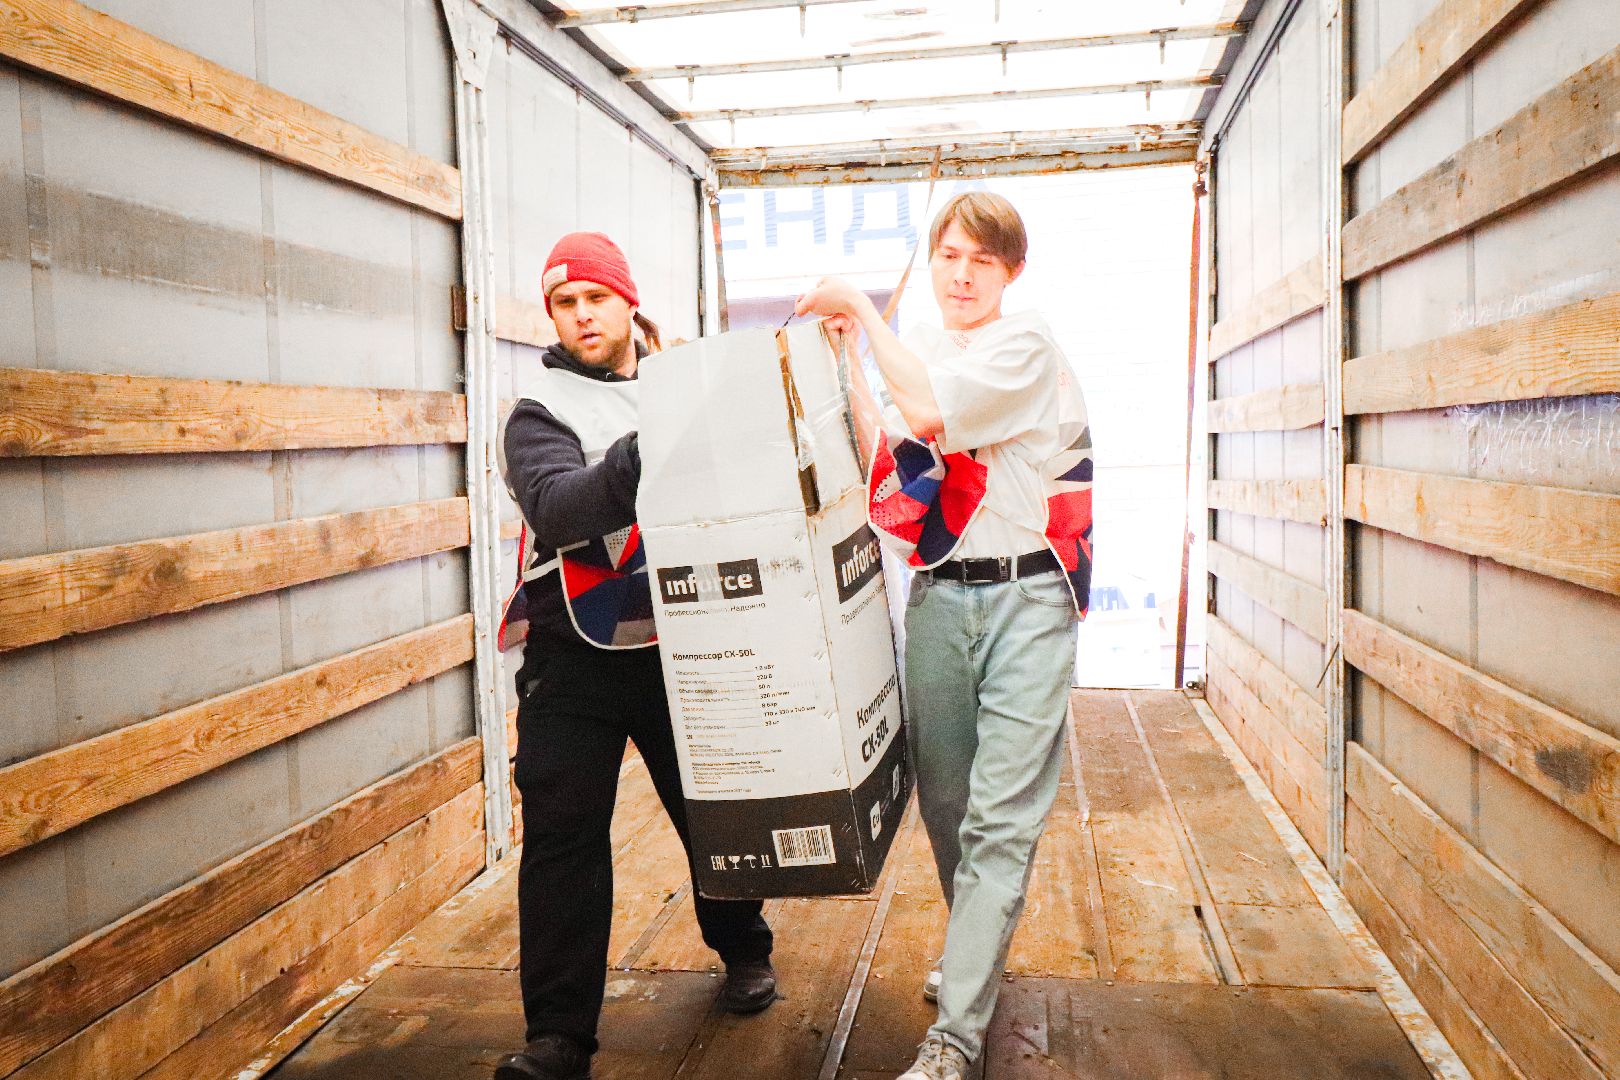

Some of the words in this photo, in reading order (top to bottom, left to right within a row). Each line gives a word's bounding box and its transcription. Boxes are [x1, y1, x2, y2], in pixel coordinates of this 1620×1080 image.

[672, 652, 723, 662] Компрессор
[724, 648, 756, 659] CX-50L
[856, 673, 896, 729] Компрессор
[861, 715, 889, 763] CX-50L
